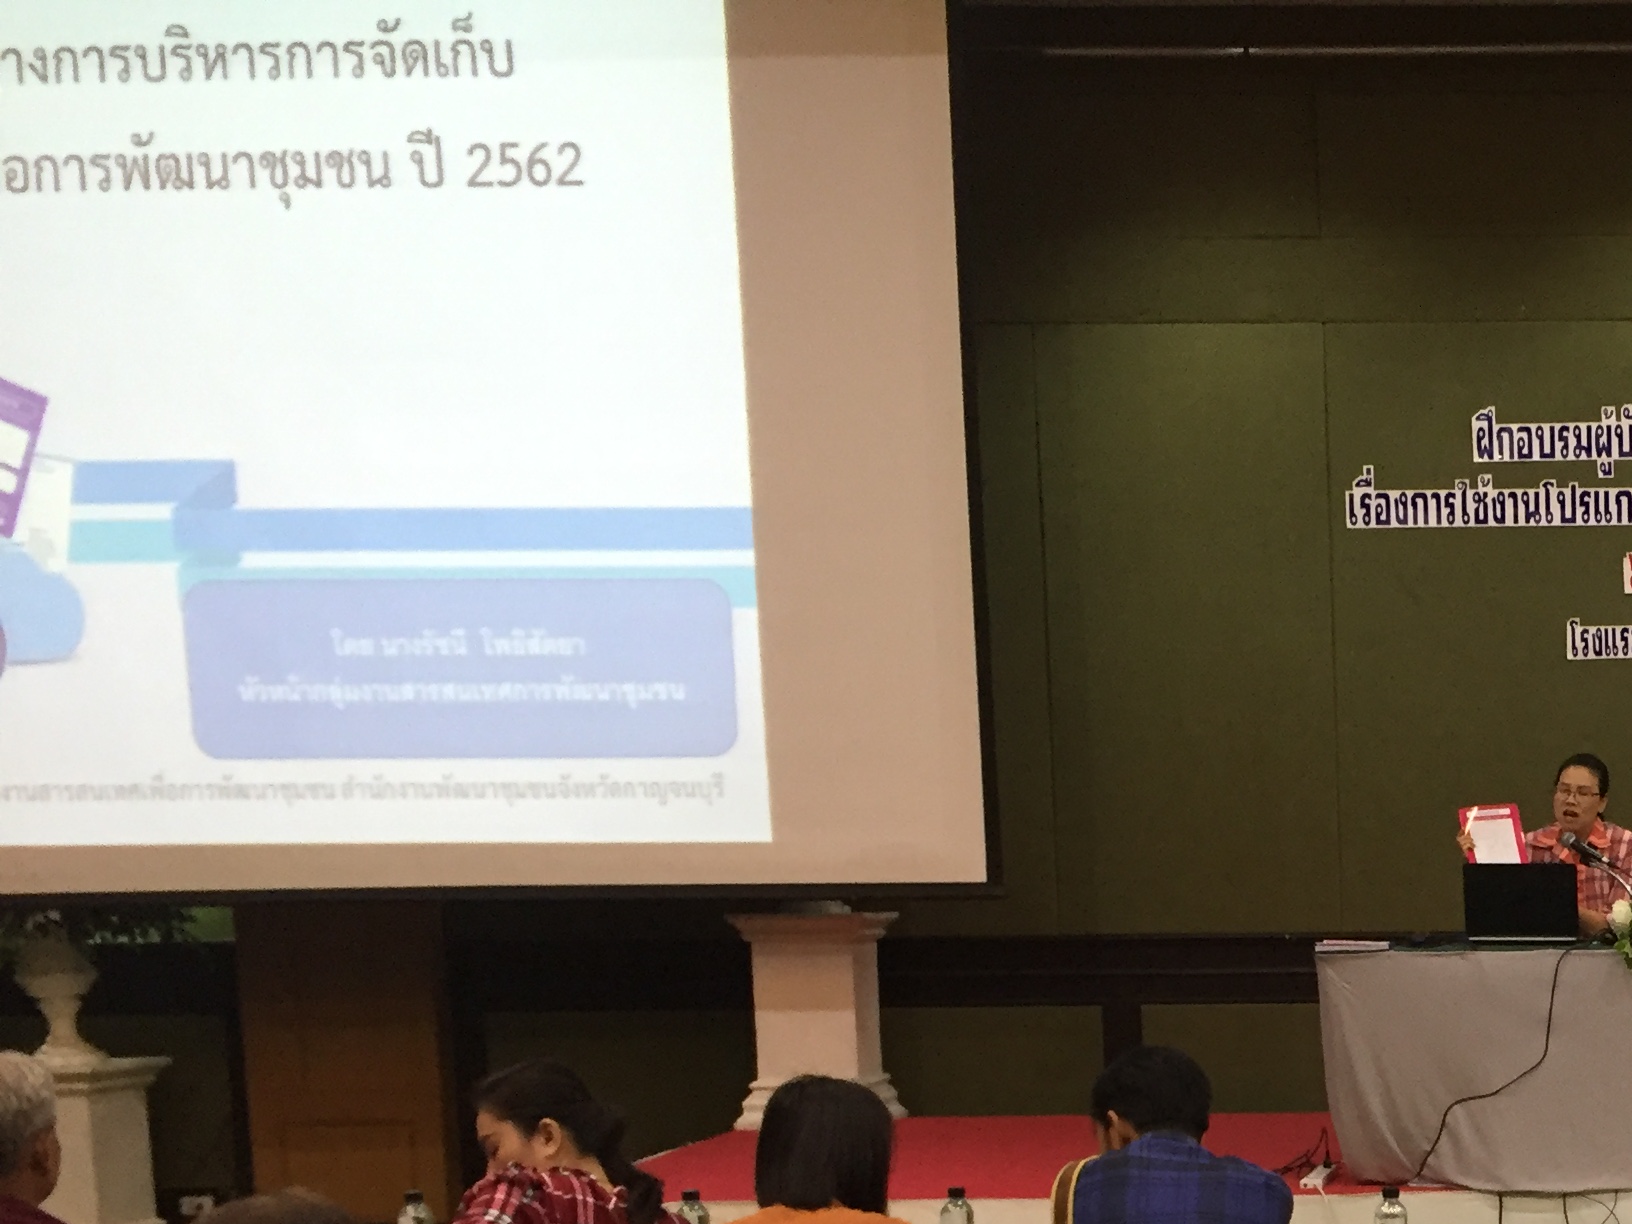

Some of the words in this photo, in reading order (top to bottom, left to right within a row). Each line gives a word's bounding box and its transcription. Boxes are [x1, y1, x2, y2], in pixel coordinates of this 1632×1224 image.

[0, 12, 515, 86] างการบริหารการจัดเก็บ
[2, 131, 393, 211] อการพัฒนาชุมชน
[406, 128, 446, 190] ปี
[467, 141, 585, 189] 2562
